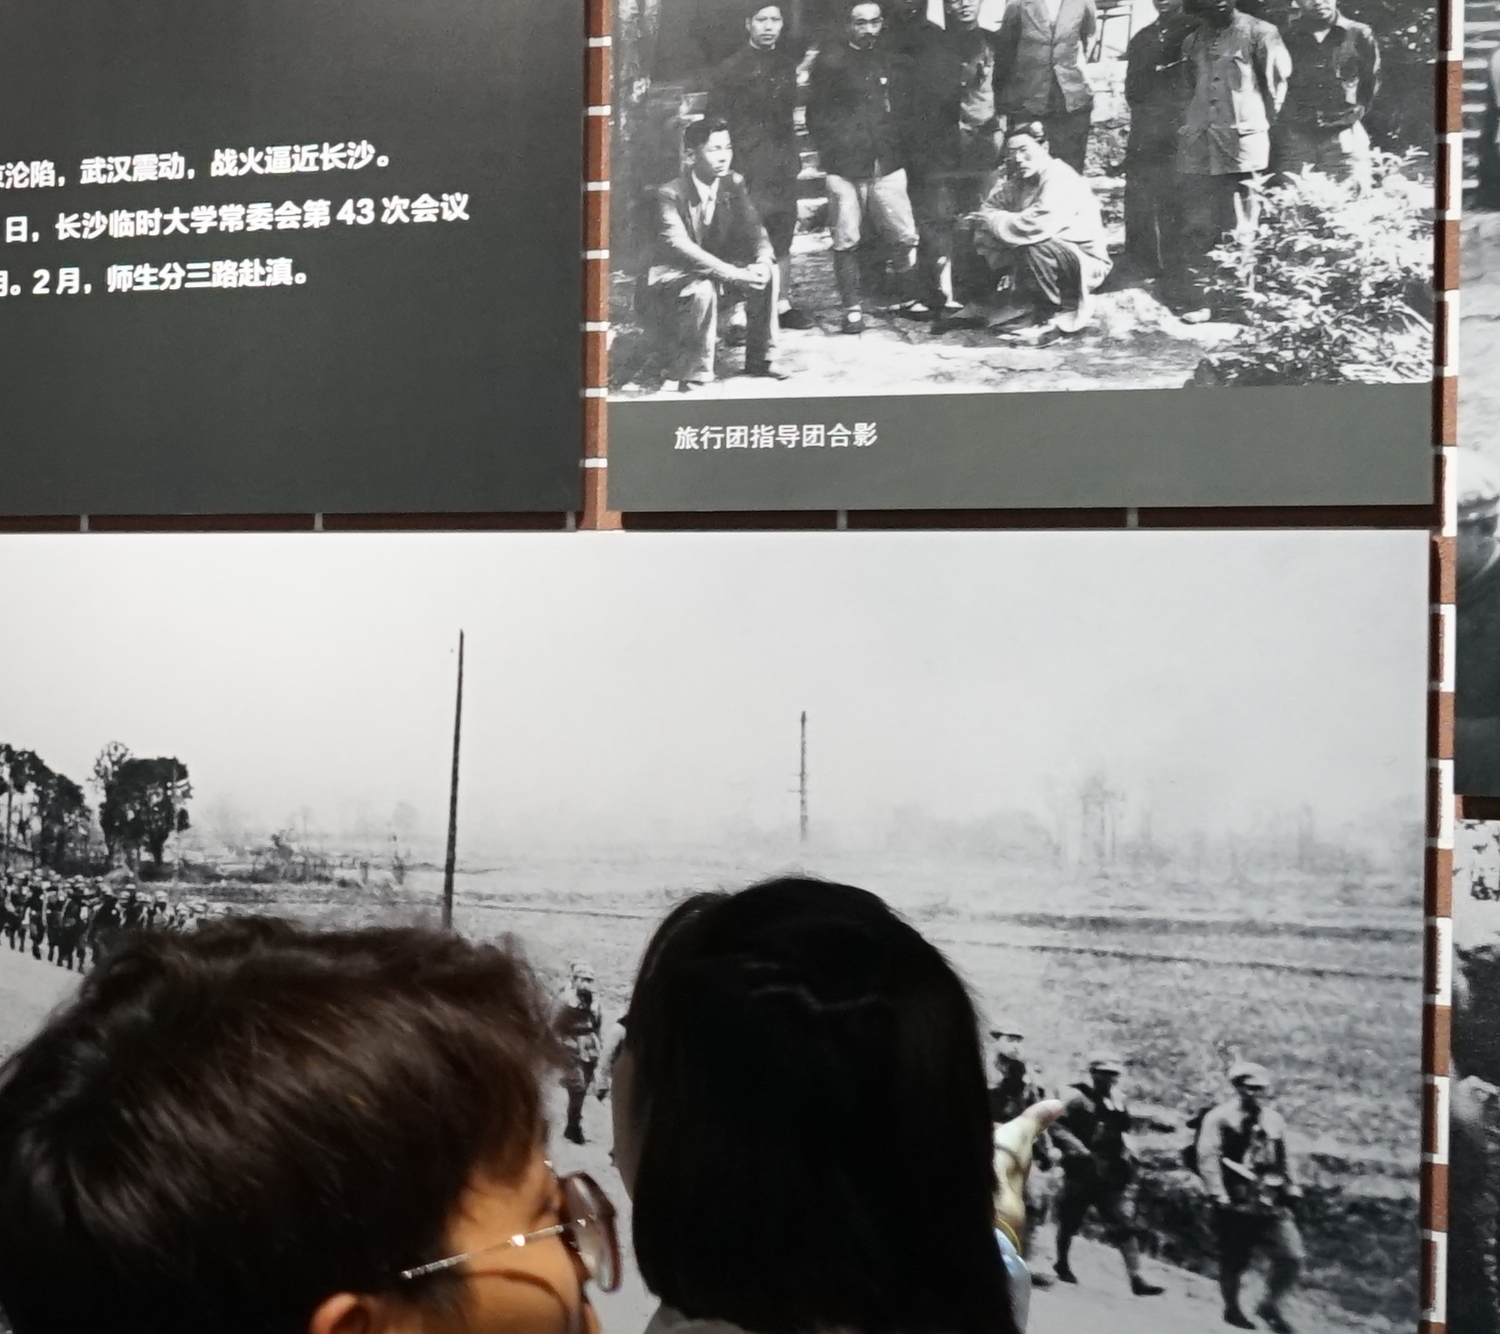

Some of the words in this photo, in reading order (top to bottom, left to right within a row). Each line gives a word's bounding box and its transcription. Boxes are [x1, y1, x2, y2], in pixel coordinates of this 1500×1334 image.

[675, 421, 877, 451] 旅行团指导团合影
